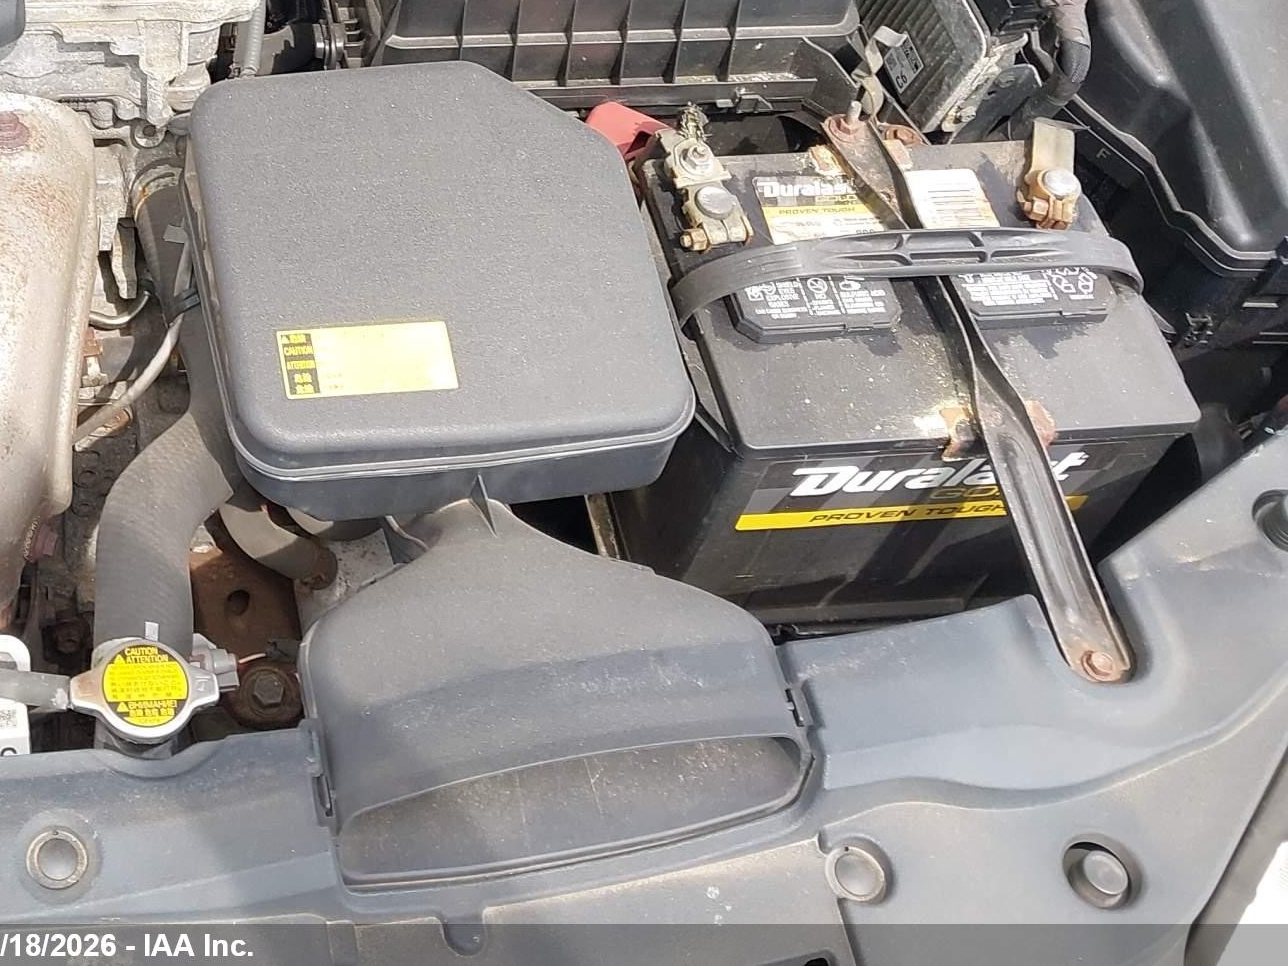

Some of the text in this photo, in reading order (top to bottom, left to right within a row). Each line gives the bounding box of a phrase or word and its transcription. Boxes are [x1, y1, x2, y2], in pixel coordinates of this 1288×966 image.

[284, 346, 314, 356] CAUTION
[790, 451, 1089, 497] Duralat
[809, 508, 918, 522] PROVEN
[124, 647, 158, 656] CAUTION
[126, 654, 169, 664] ATTENTION
